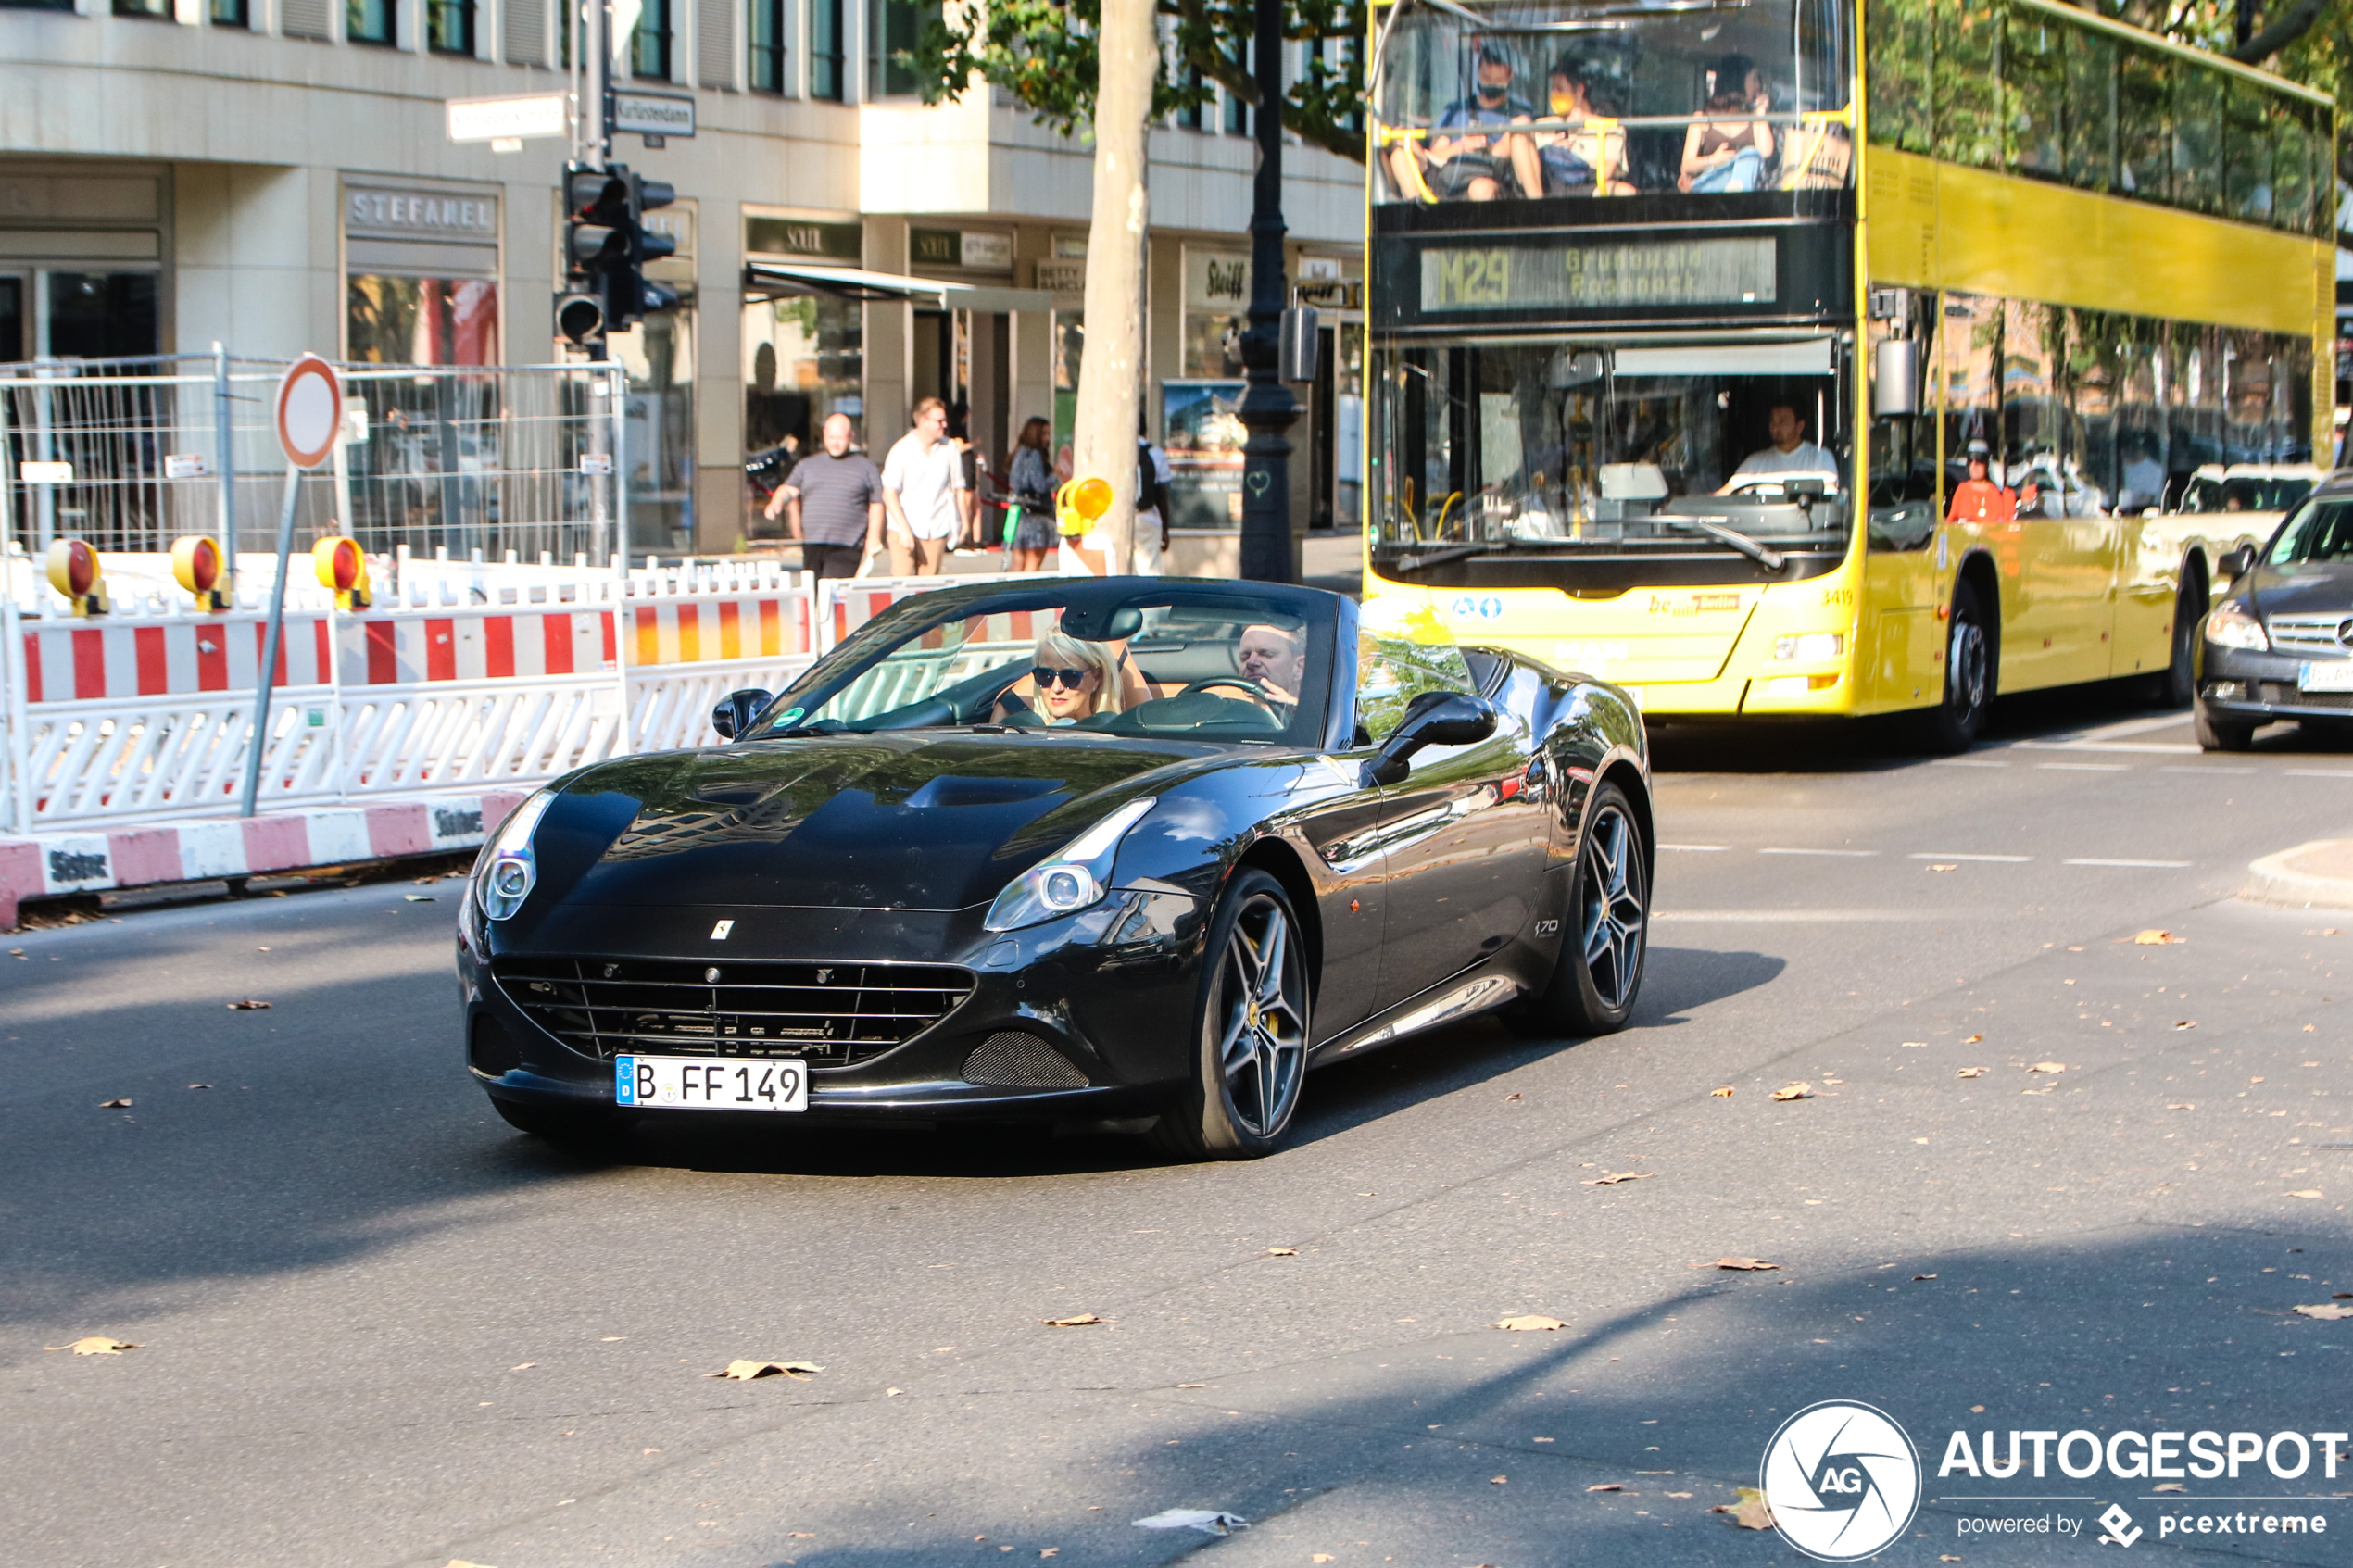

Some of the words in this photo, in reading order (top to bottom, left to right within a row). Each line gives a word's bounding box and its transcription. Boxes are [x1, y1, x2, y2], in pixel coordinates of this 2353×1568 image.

[352, 192, 490, 228] STEFANEL
[1206, 258, 1246, 301] Steiff
[1438, 250, 1510, 305] M29
[1700, 595, 1737, 609] Berlin
[1821, 588, 1854, 607] 3419
[1555, 642, 1629, 659] MAN
[1540, 919, 1559, 933] 70
[622, 1085, 630, 1097] D
[636, 1064, 656, 1098] B
[682, 1065, 725, 1100] FF
[735, 1067, 799, 1103] 149
